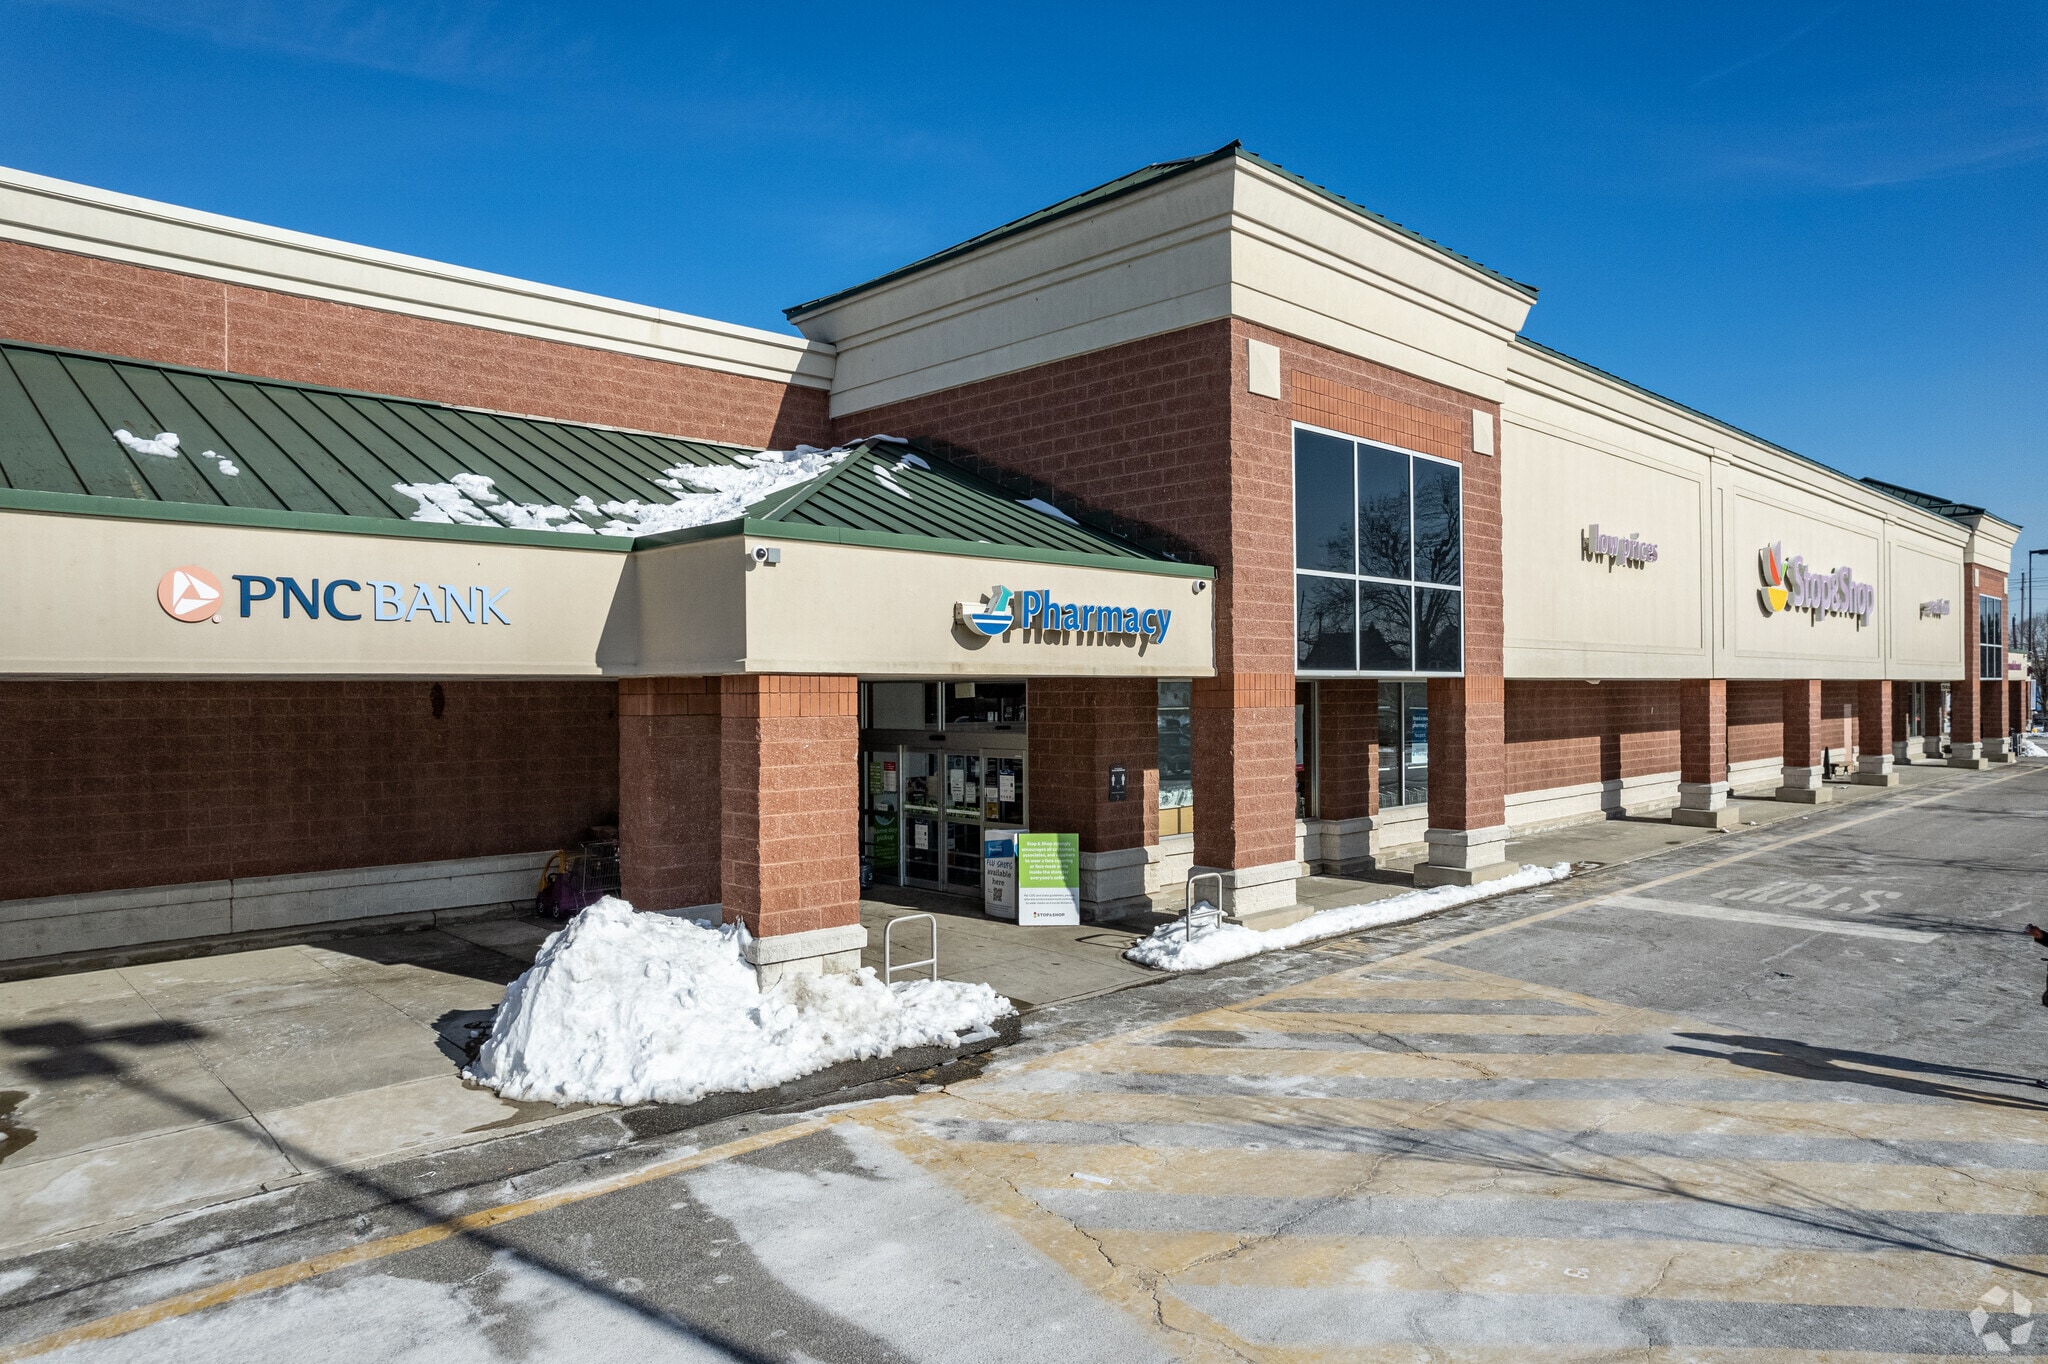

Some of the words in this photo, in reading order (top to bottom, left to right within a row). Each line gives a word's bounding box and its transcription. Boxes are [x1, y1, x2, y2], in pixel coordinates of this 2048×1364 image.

[1588, 523, 1618, 556] low
[1617, 533, 1658, 566] prices
[232, 574, 362, 621] PNC
[366, 579, 512, 625] BANK
[1020, 588, 1172, 645] Pharmacy
[987, 868, 1012, 878] available
[991, 877, 1005, 886] here
